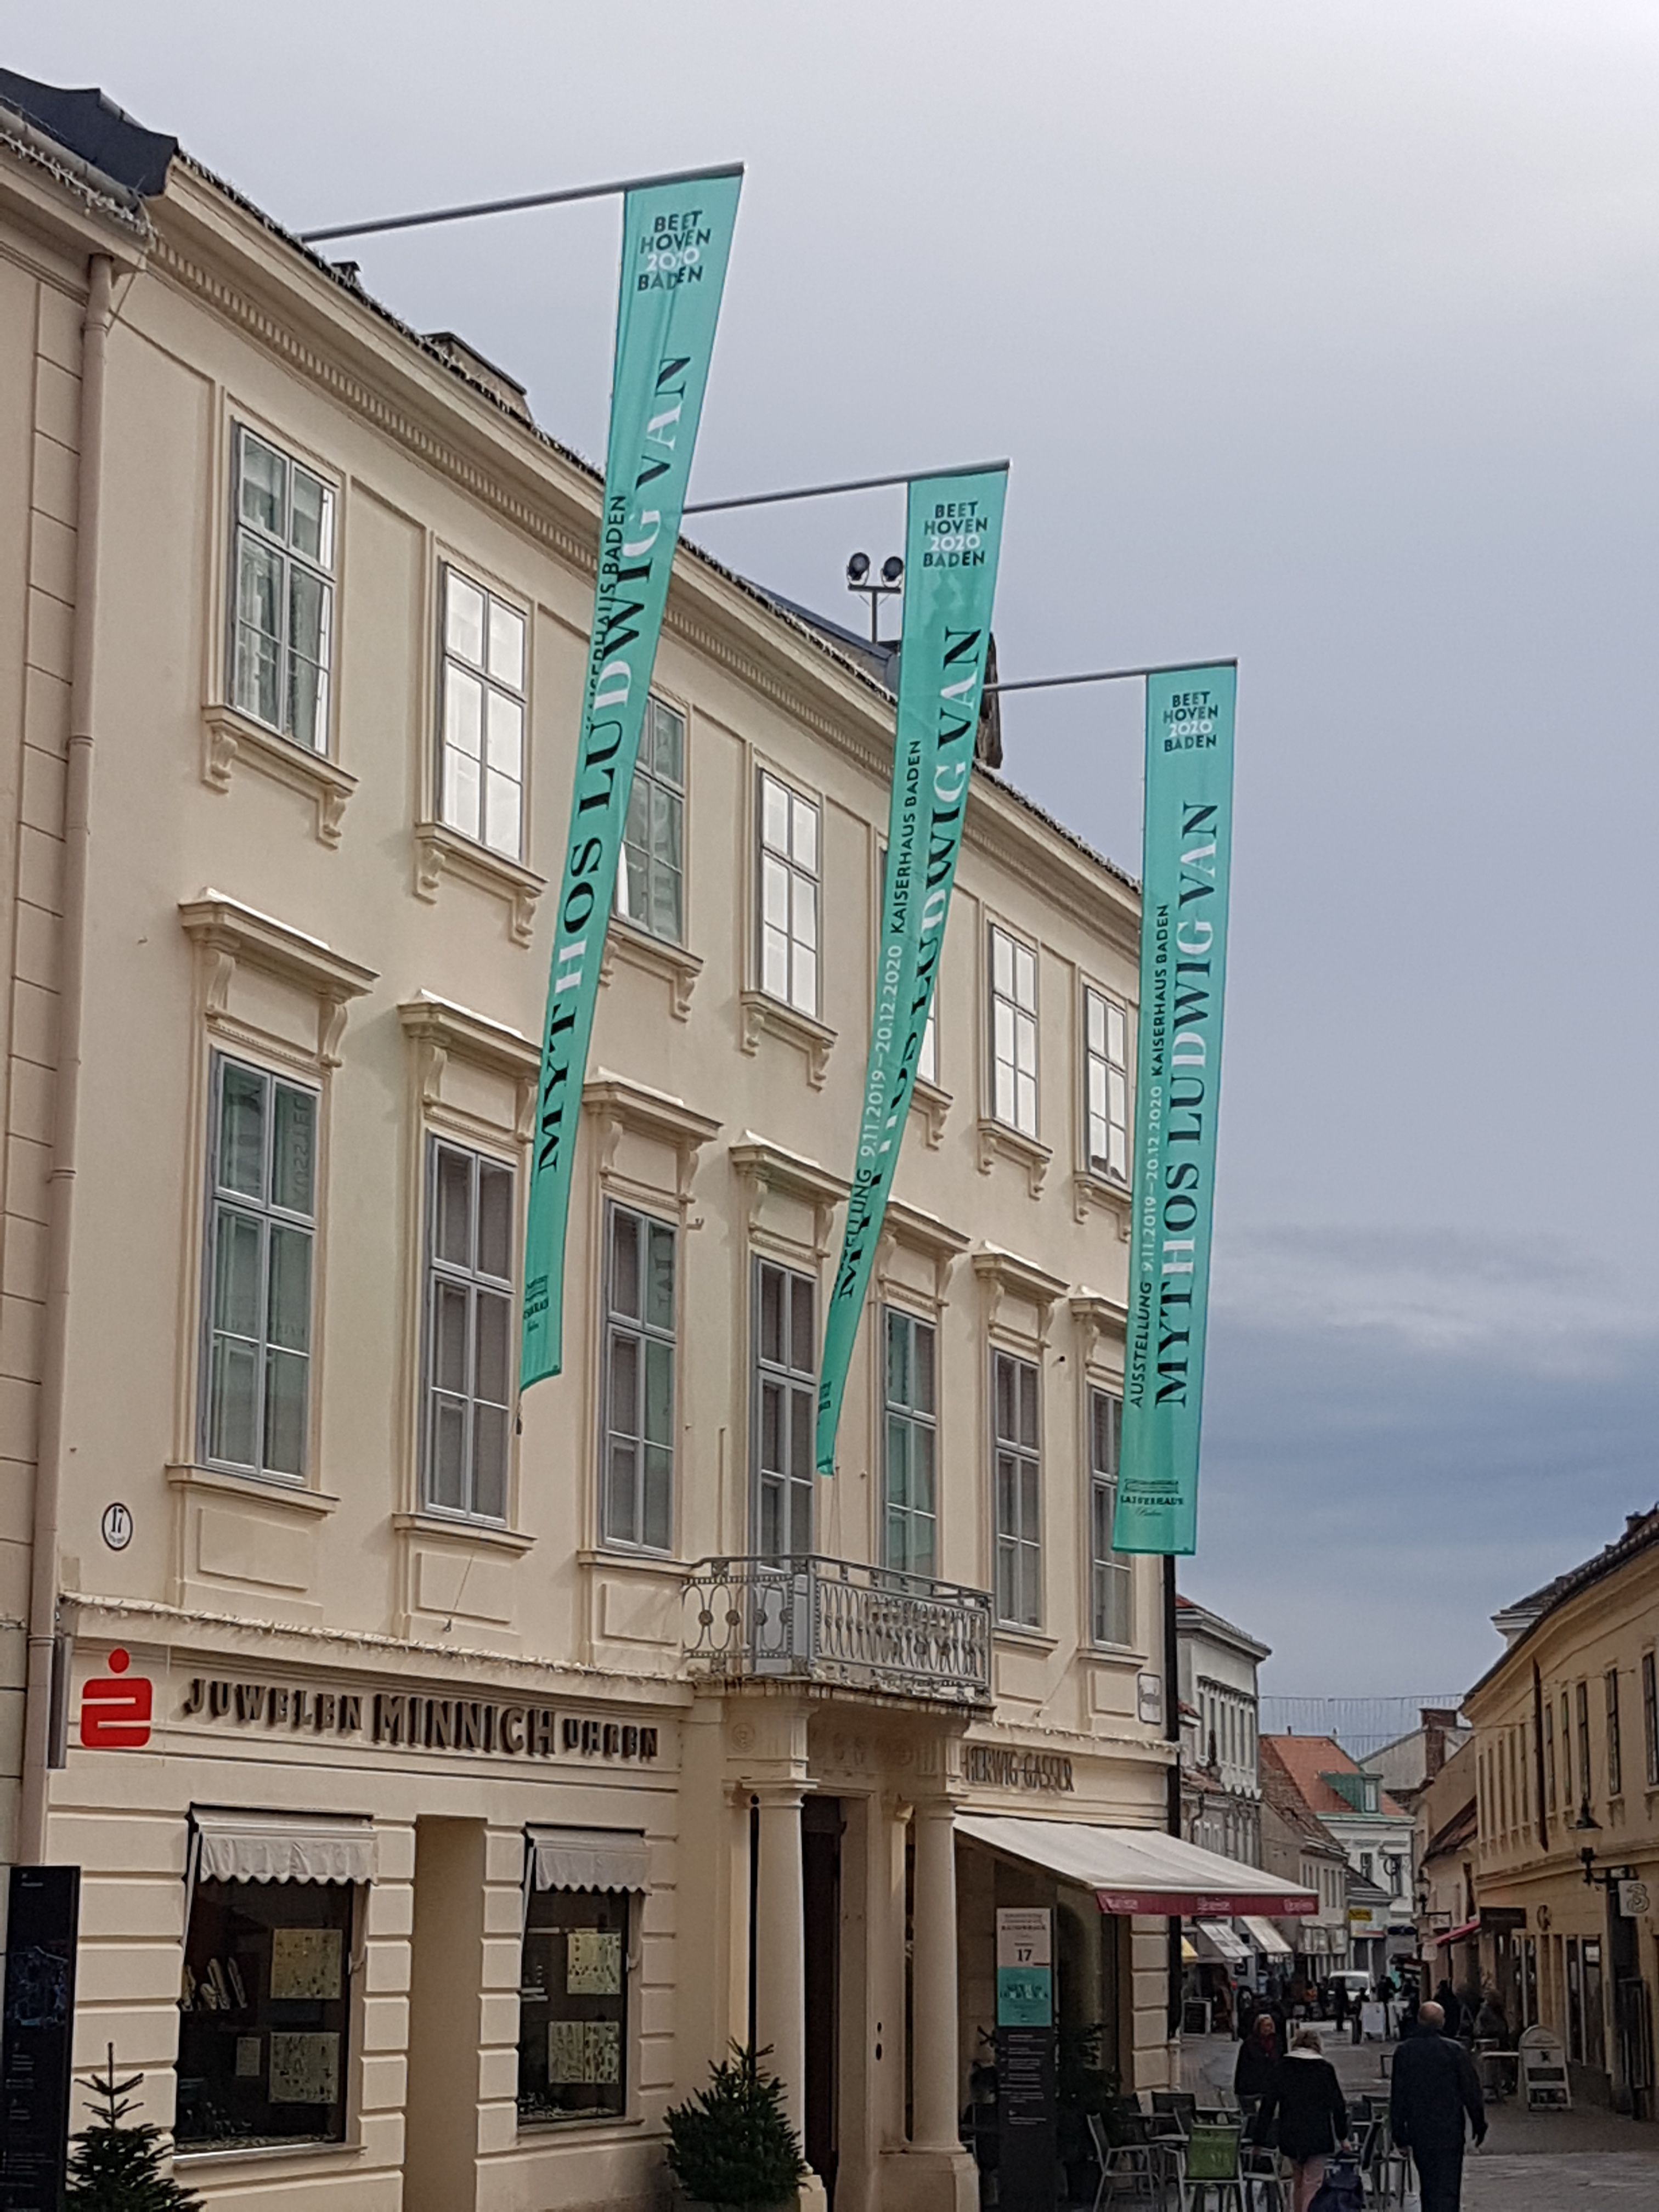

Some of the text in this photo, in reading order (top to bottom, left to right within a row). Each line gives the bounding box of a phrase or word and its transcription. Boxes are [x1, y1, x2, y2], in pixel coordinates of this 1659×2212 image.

[654, 209, 703, 233] BEET
[640, 228, 710, 254] HOVEN
[637, 266, 703, 291] BADEN
[935, 500, 978, 518] BEET
[602, 496, 626, 574] BADEN
[924, 517, 988, 535] HOVEN
[931, 534, 980, 551] 2020
[923, 550, 985, 568] BADEN
[937, 625, 982, 751] VAN
[1172, 691, 1211, 707] BEET
[1164, 704, 1217, 724] HOVEN
[1170, 720, 1212, 737] 2020
[1164, 735, 1216, 753] BADEN
[539, 356, 691, 1172] MYTHOS LUDWIG VAN
[890, 812, 916, 934] KAISERHAUS
[905, 740, 922, 808] BADEN
[1156, 904, 1169, 963] BADEN
[1151, 969, 1167, 1077] KAISERHAUS
[1155, 800, 1218, 1409] MYTHOS LUDWIG VAN
[1130, 1282, 1152, 1408] AUSSTELLUNG
[111, 1506, 124, 1533] 17
[183, 1678, 658, 1759] JUWELEN MINNICH UHREN
[1017, 1948, 1032, 1962] 17
